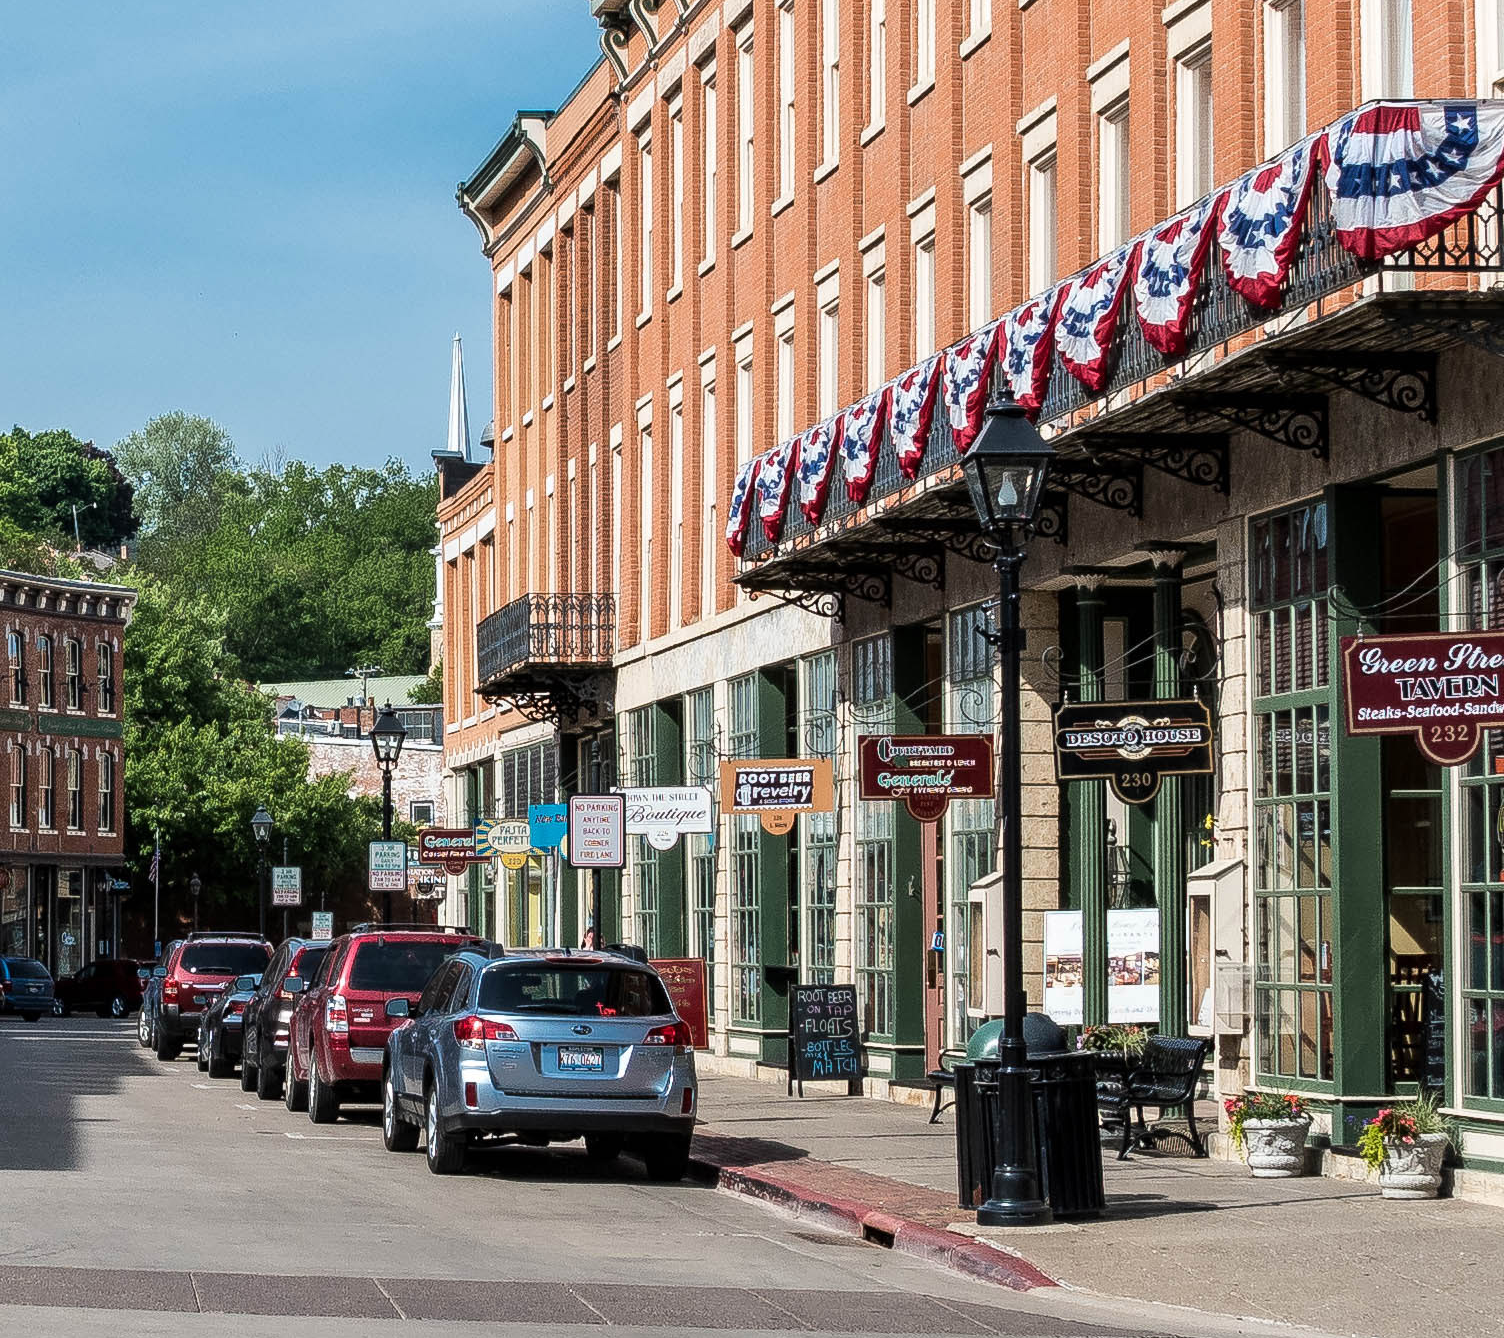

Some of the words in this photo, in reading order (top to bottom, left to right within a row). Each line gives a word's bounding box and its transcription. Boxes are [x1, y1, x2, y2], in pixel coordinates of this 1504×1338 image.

[1359, 647, 1438, 674] Green
[1395, 674, 1499, 700] TAVERN
[1066, 731, 1138, 747] DESOTO
[1142, 729, 1201, 744] HOUSE
[1431, 725, 1469, 742] 232
[739, 773, 776, 784] ROOT
[779, 771, 811, 783] BEER
[1122, 773, 1151, 788] 230
[669, 793, 698, 801] STREET
[752, 782, 812, 803] revelry
[575, 804, 585, 812] NO
[587, 803, 618, 812] PARKING
[626, 804, 706, 826] Boutique
[535, 814, 552, 823] New
[500, 826, 527, 835] PASTA
[424, 836, 474, 849] General
[491, 836, 530, 845] PERFETT
[798, 989, 826, 1004] ROOT
[828, 990, 852, 1004] BEER
[807, 1005, 821, 1014] ON
[826, 1005, 853, 1016] TAP
[806, 1018, 853, 1037] FLOATS
[813, 1058, 857, 1077] MATCH
